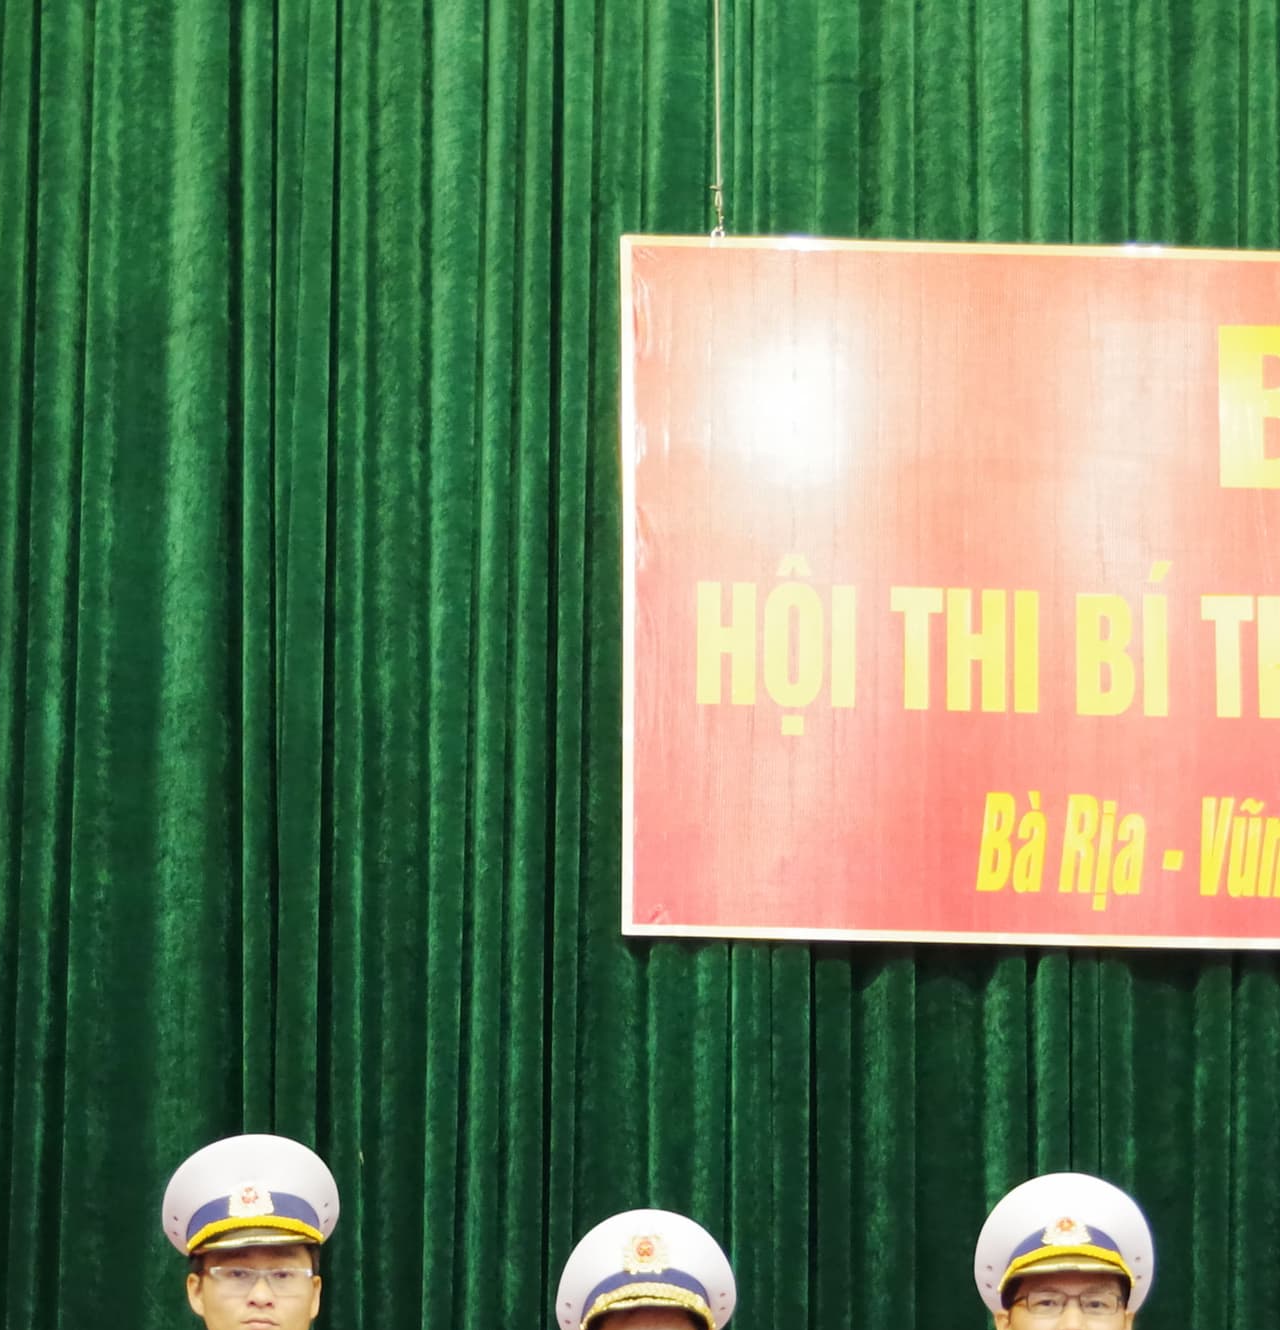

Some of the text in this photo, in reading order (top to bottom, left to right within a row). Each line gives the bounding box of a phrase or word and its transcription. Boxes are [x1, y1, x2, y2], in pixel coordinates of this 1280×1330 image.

[695, 553, 857, 736] HỘI
[890, 586, 1039, 714] THI
[1075, 560, 1173, 717] BÍ
[976, 790, 1047, 894] Bà
[1058, 793, 1146, 913] Rịa
[1162, 849, 1183, 871] -
